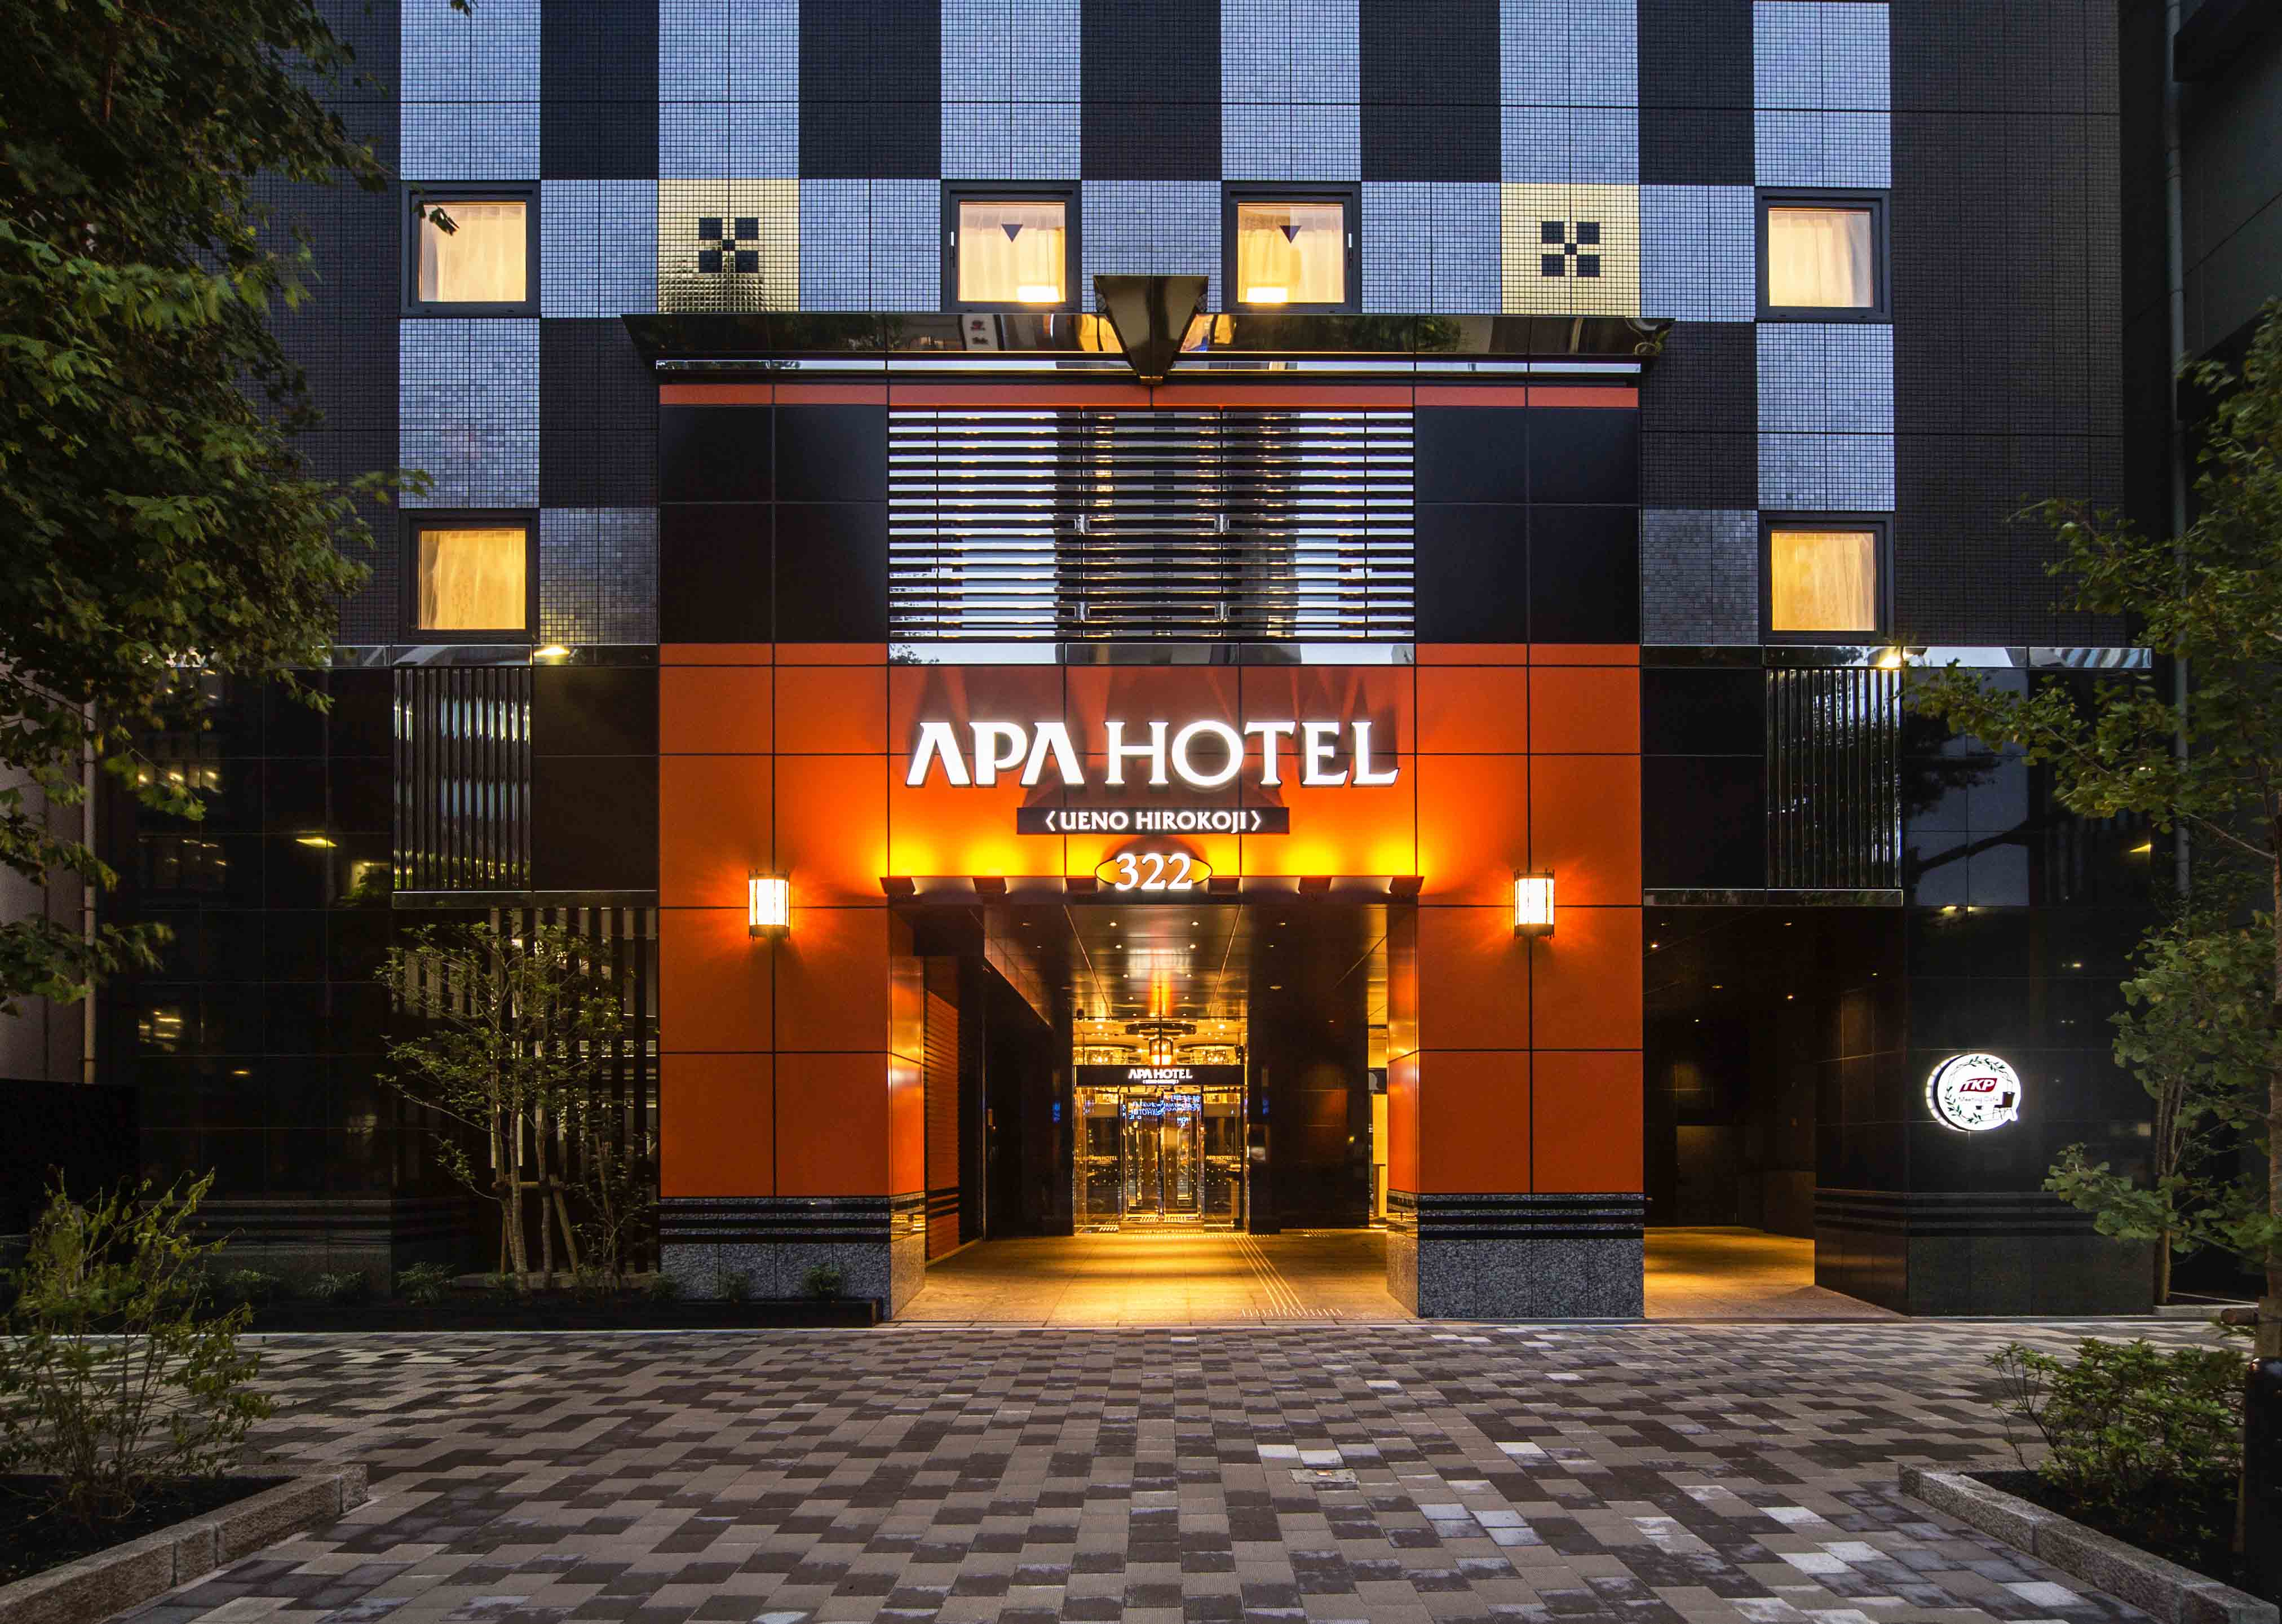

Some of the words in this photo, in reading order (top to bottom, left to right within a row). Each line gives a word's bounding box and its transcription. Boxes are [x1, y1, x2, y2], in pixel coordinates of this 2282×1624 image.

[905, 722, 1086, 786] APA
[1105, 720, 1400, 787] HOTEL
[1115, 853, 1193, 890] 322
[1128, 1069, 1152, 1079] APA
[1153, 1068, 1193, 1079] HOTEL
[1962, 1079, 1996, 1091] TKP
